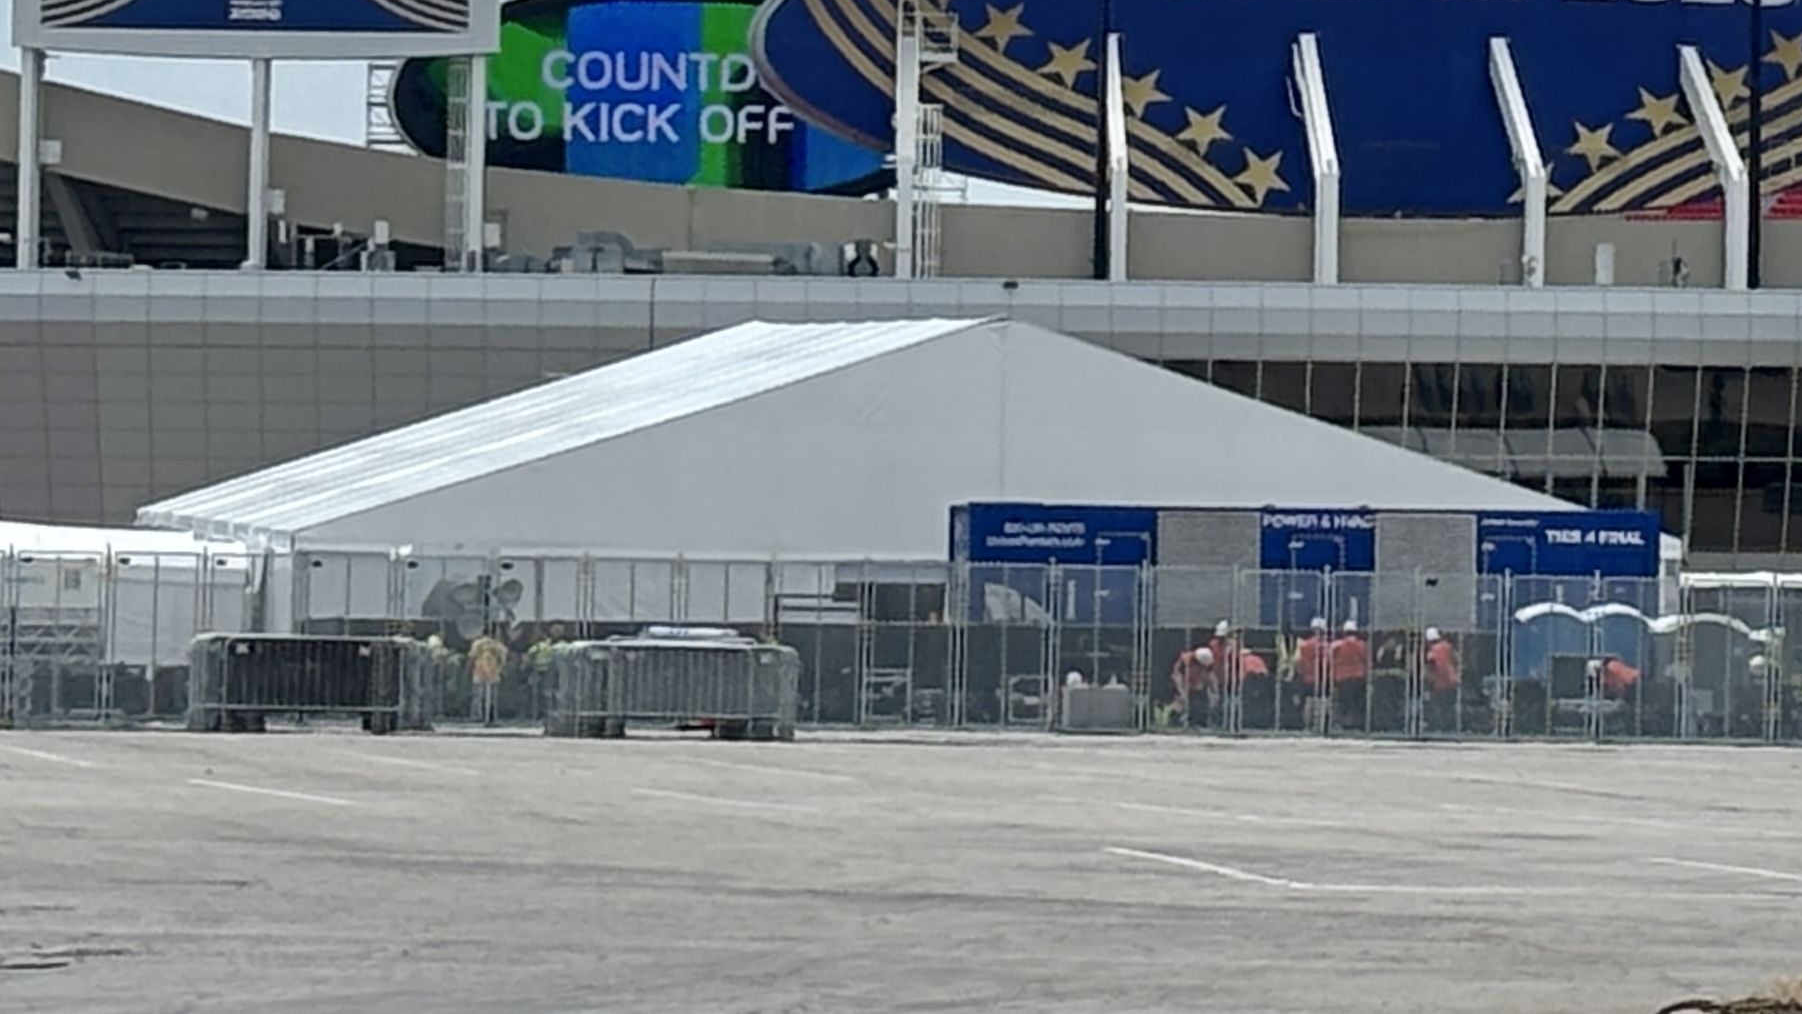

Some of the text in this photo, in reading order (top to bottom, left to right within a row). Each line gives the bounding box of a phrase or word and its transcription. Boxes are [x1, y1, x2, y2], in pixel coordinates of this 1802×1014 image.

[541, 50, 757, 92] COUNTD
[485, 101, 795, 146] TO KICK OFF
